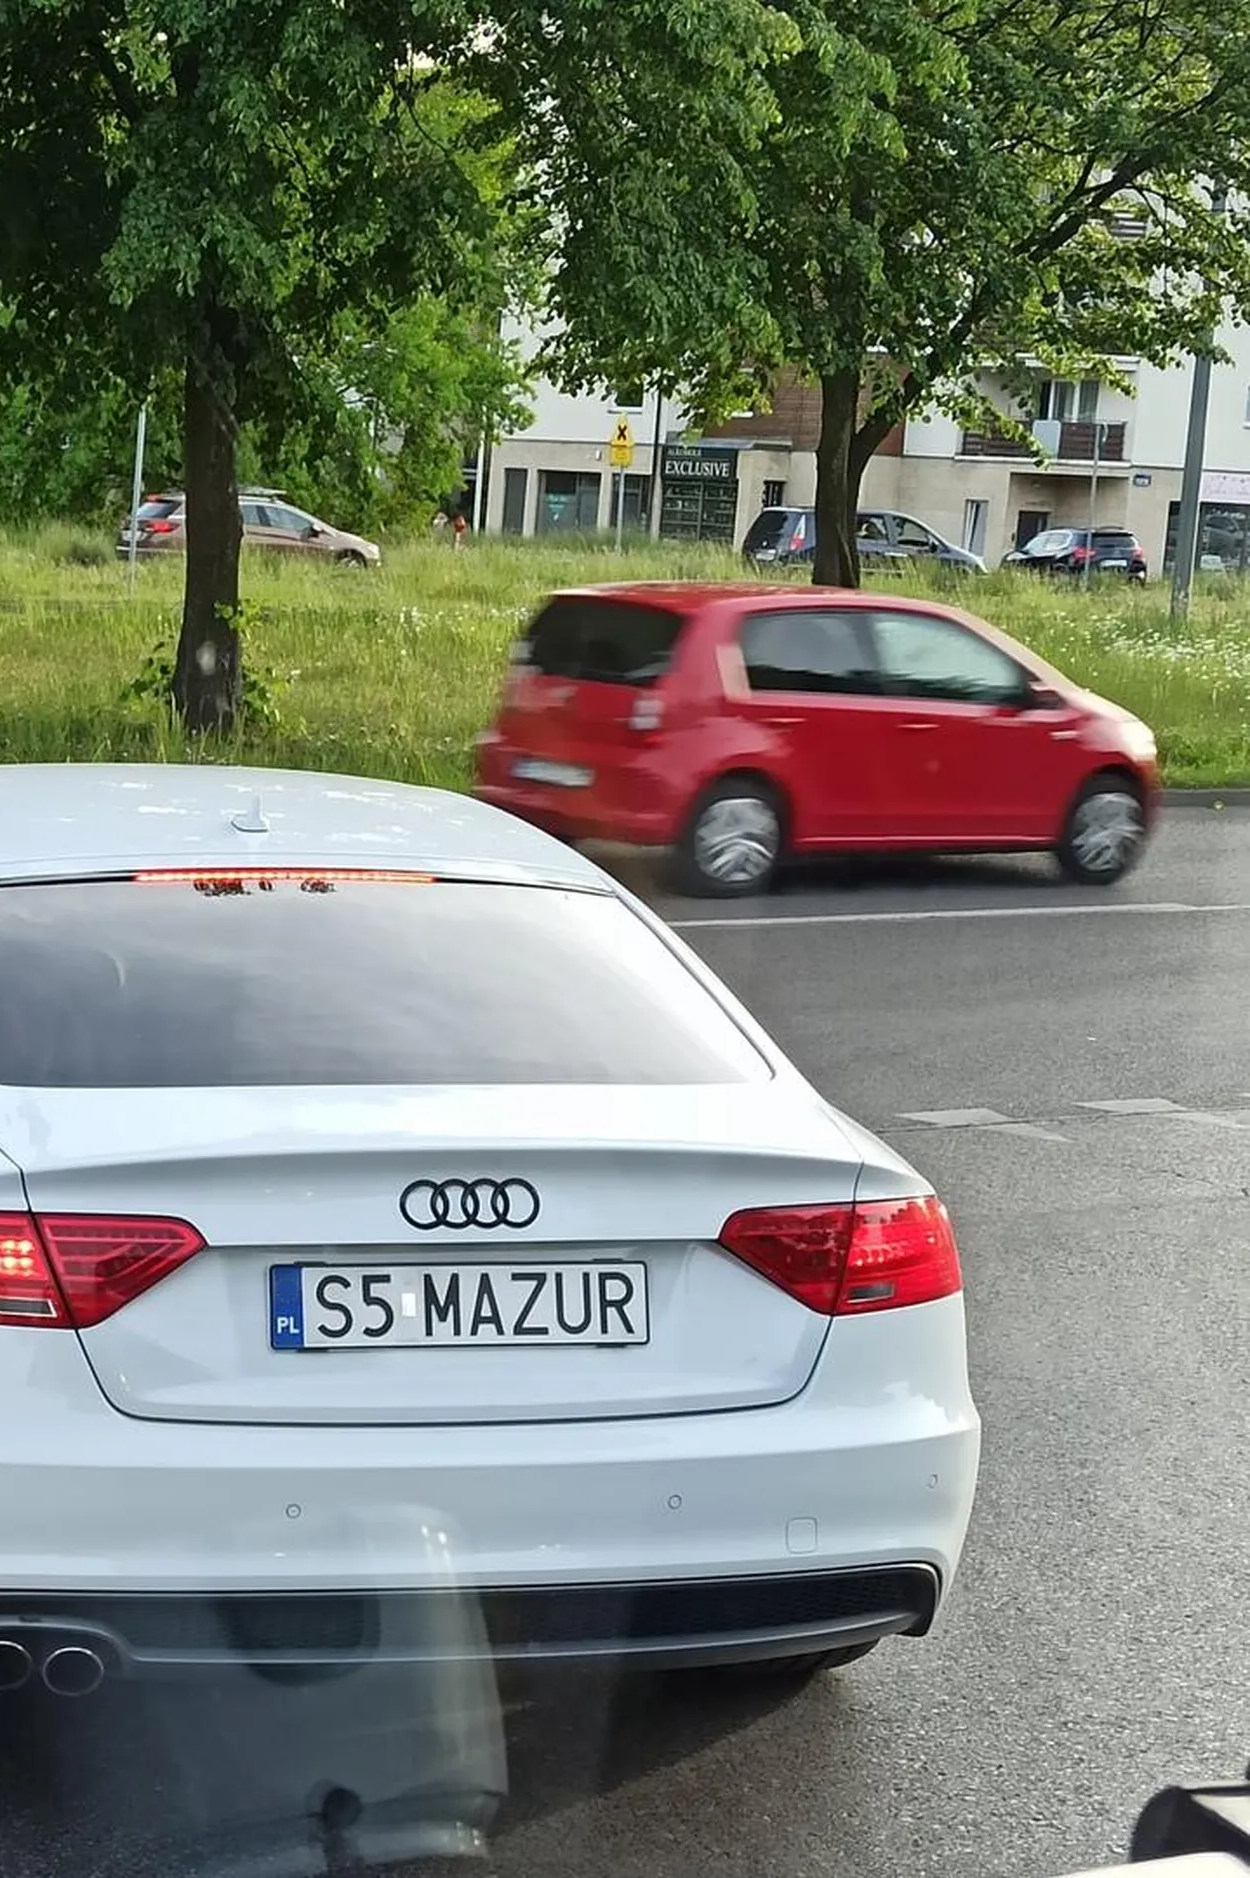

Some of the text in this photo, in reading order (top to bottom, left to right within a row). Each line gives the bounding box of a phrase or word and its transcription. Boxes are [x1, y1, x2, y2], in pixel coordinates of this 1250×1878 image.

[665, 460, 730, 477] EXCLUSIVE
[316, 1272, 635, 1338] S5 MAZUR
[276, 1316, 300, 1334] PL
